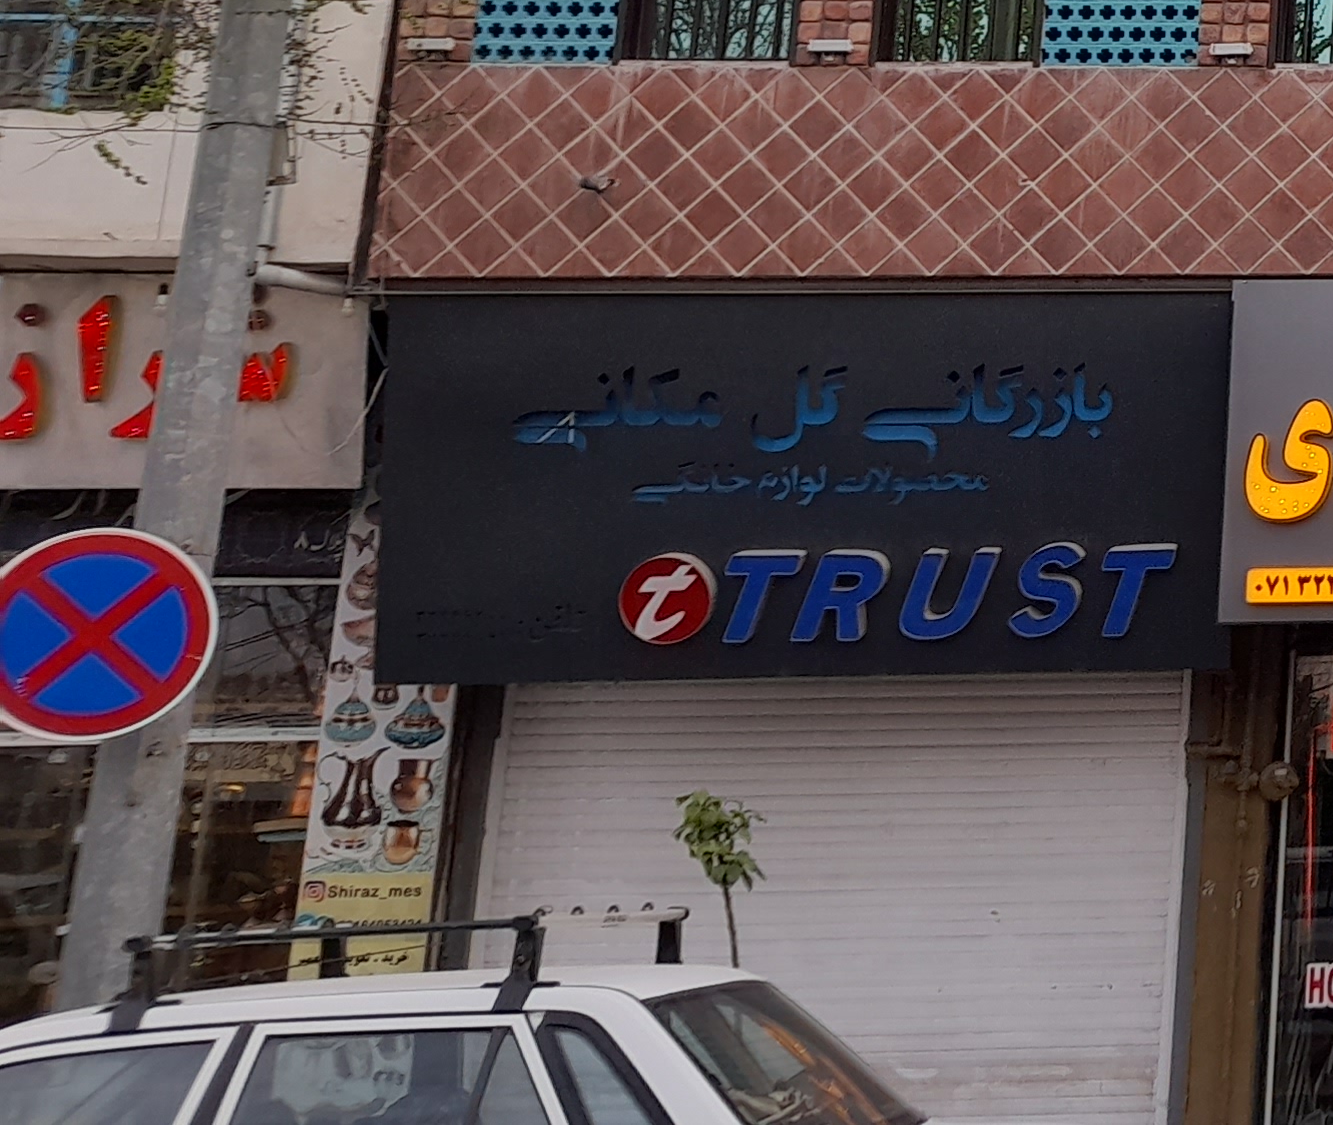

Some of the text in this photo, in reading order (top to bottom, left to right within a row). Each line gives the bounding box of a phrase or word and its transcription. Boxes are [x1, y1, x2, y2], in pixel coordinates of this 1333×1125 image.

[750, 363, 848, 452] گل
[862, 362, 1115, 463] بازرگانی
[629, 461, 990, 506] محصولات لوازم خانگی
[721, 542, 1178, 644] TRUST
[328, 885, 422, 899] Shiraz_mes
